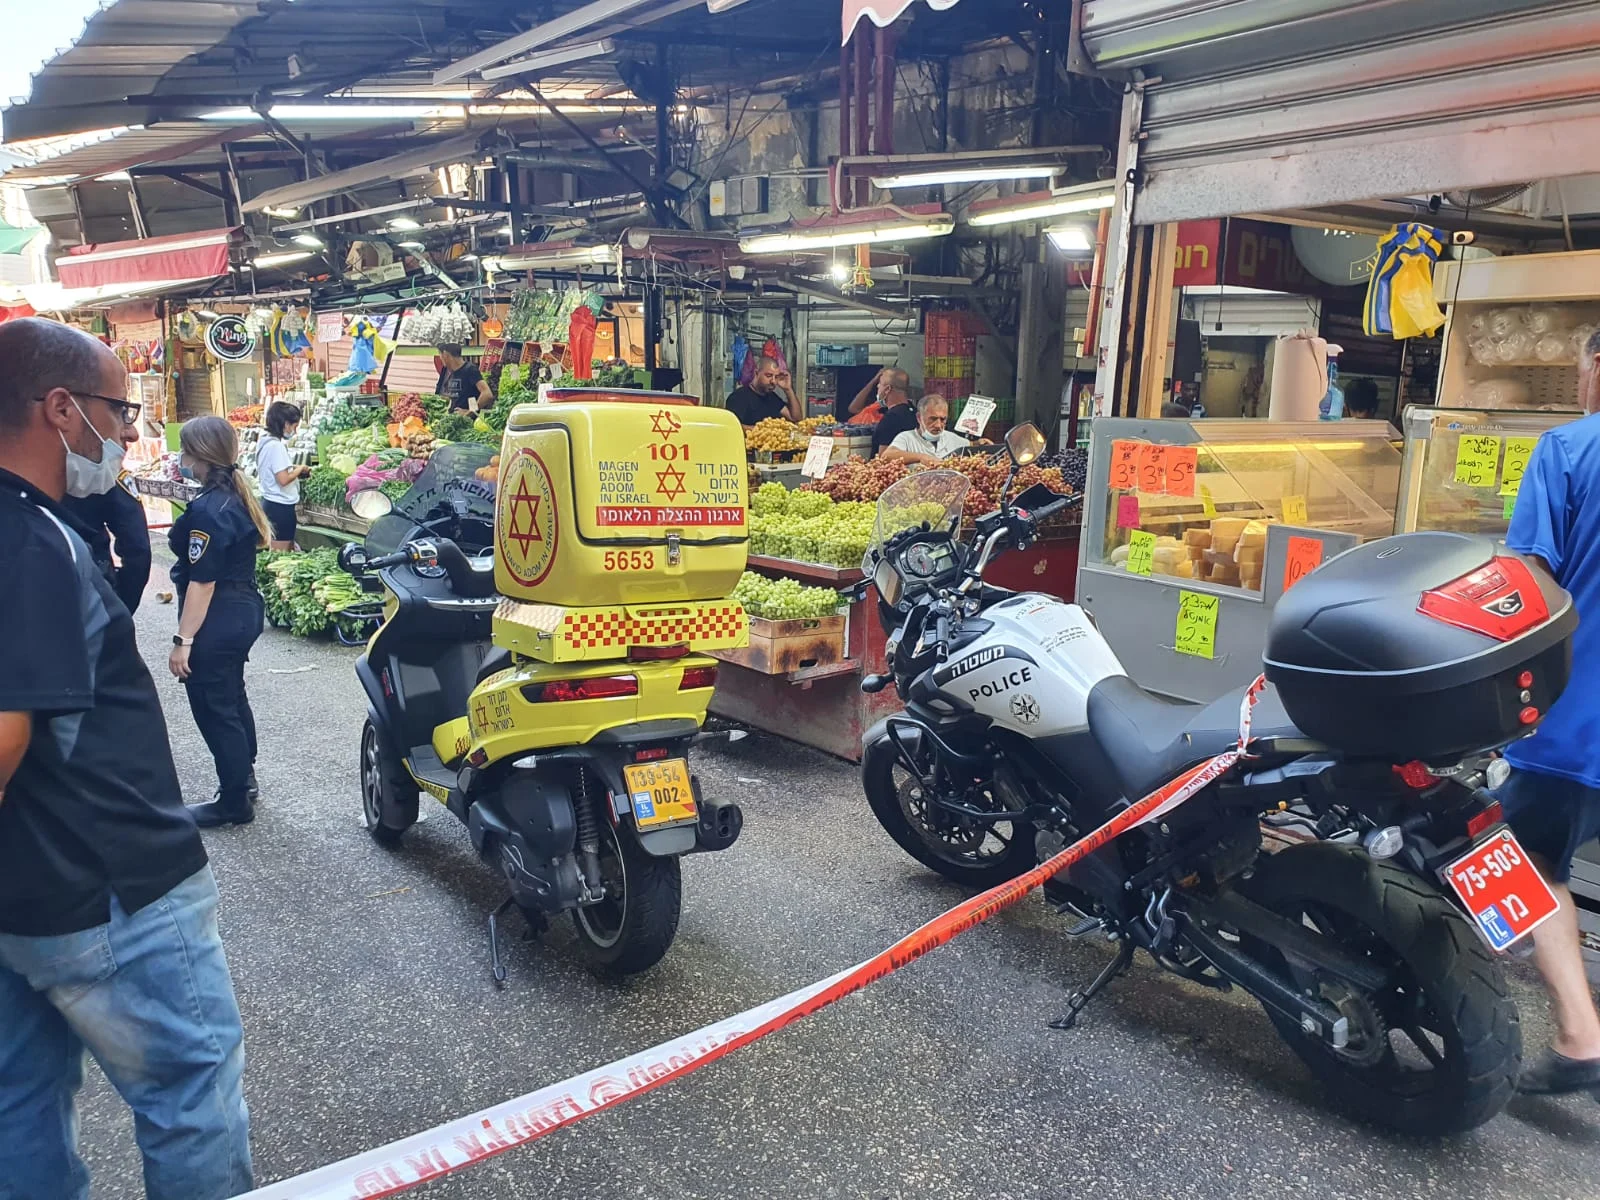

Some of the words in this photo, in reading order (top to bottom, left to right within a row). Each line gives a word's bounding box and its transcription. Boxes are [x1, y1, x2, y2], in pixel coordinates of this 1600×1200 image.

[646, 443, 690, 461] 101
[599, 461, 639, 472] MAGEN
[695, 463, 715, 475] דוד
[719, 464, 738, 477] מגן
[600, 472, 634, 482] DAVID
[600, 483, 635, 493] ADOM
[710, 478, 739, 490] אדום
[600, 494, 612, 503] IN
[616, 494, 651, 504] ISRAEL
[692, 491, 740, 504] בישראל
[602, 508, 652, 522] הלאומי
[657, 509, 702, 522] ההצלה
[708, 509, 740, 523] ארגון
[603, 551, 655, 571] 5653
[951, 646, 1005, 678] משטרה
[969, 667, 1032, 702] POLICE
[654, 786, 681, 805] 002
[1455, 842, 1521, 897] 75-503
